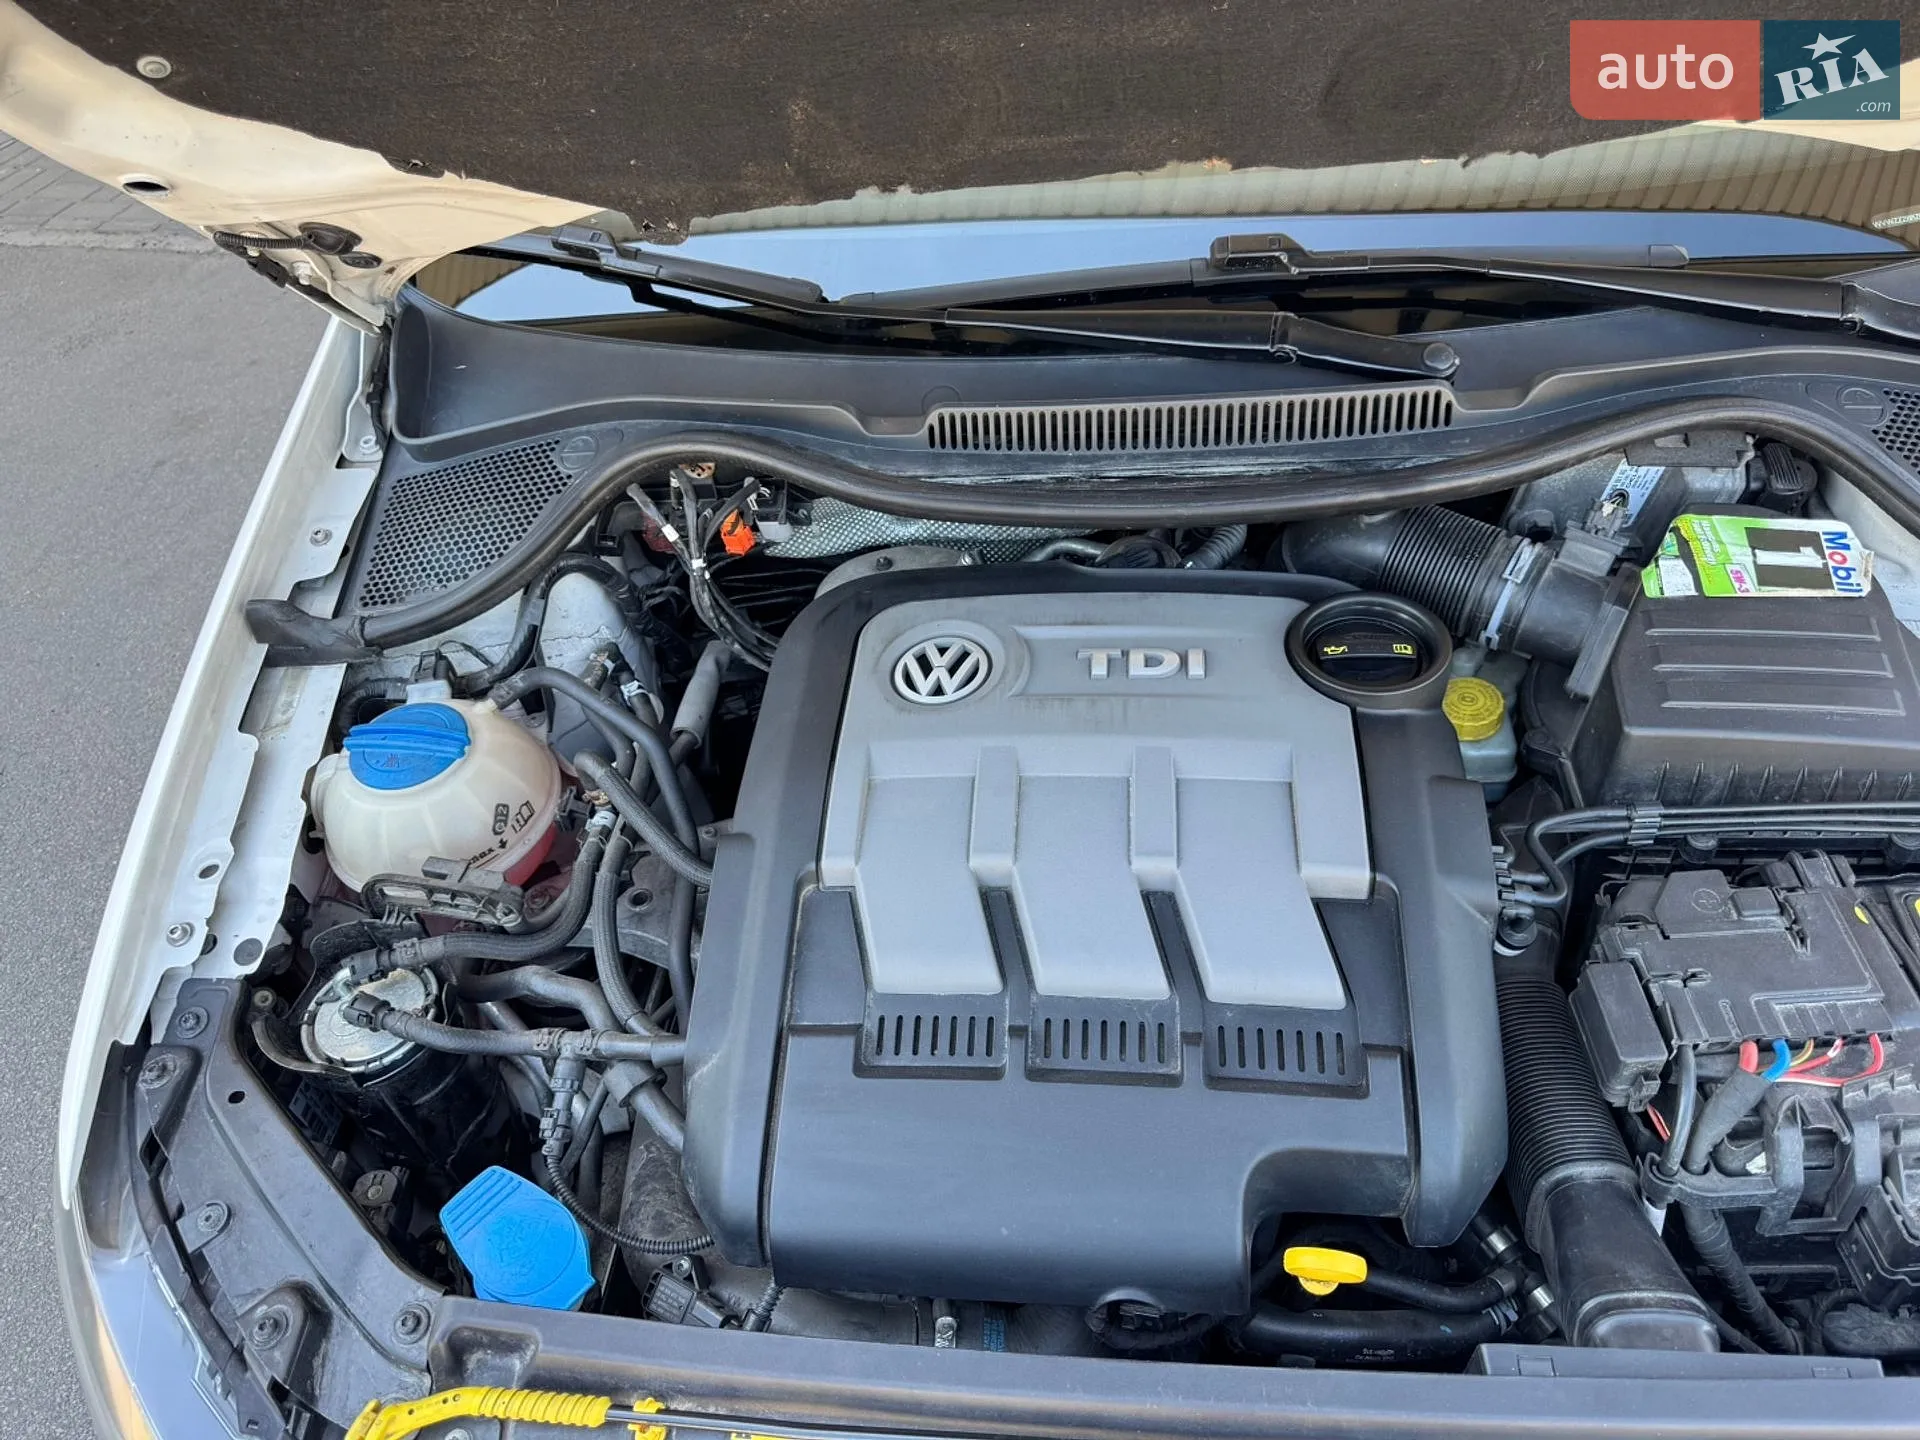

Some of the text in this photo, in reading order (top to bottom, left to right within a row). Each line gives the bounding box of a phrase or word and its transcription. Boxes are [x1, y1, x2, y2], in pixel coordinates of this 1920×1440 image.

[1754, 546, 1823, 568] 1
[1822, 531, 1863, 593] Mobil
[1077, 648, 1206, 680] TDI
